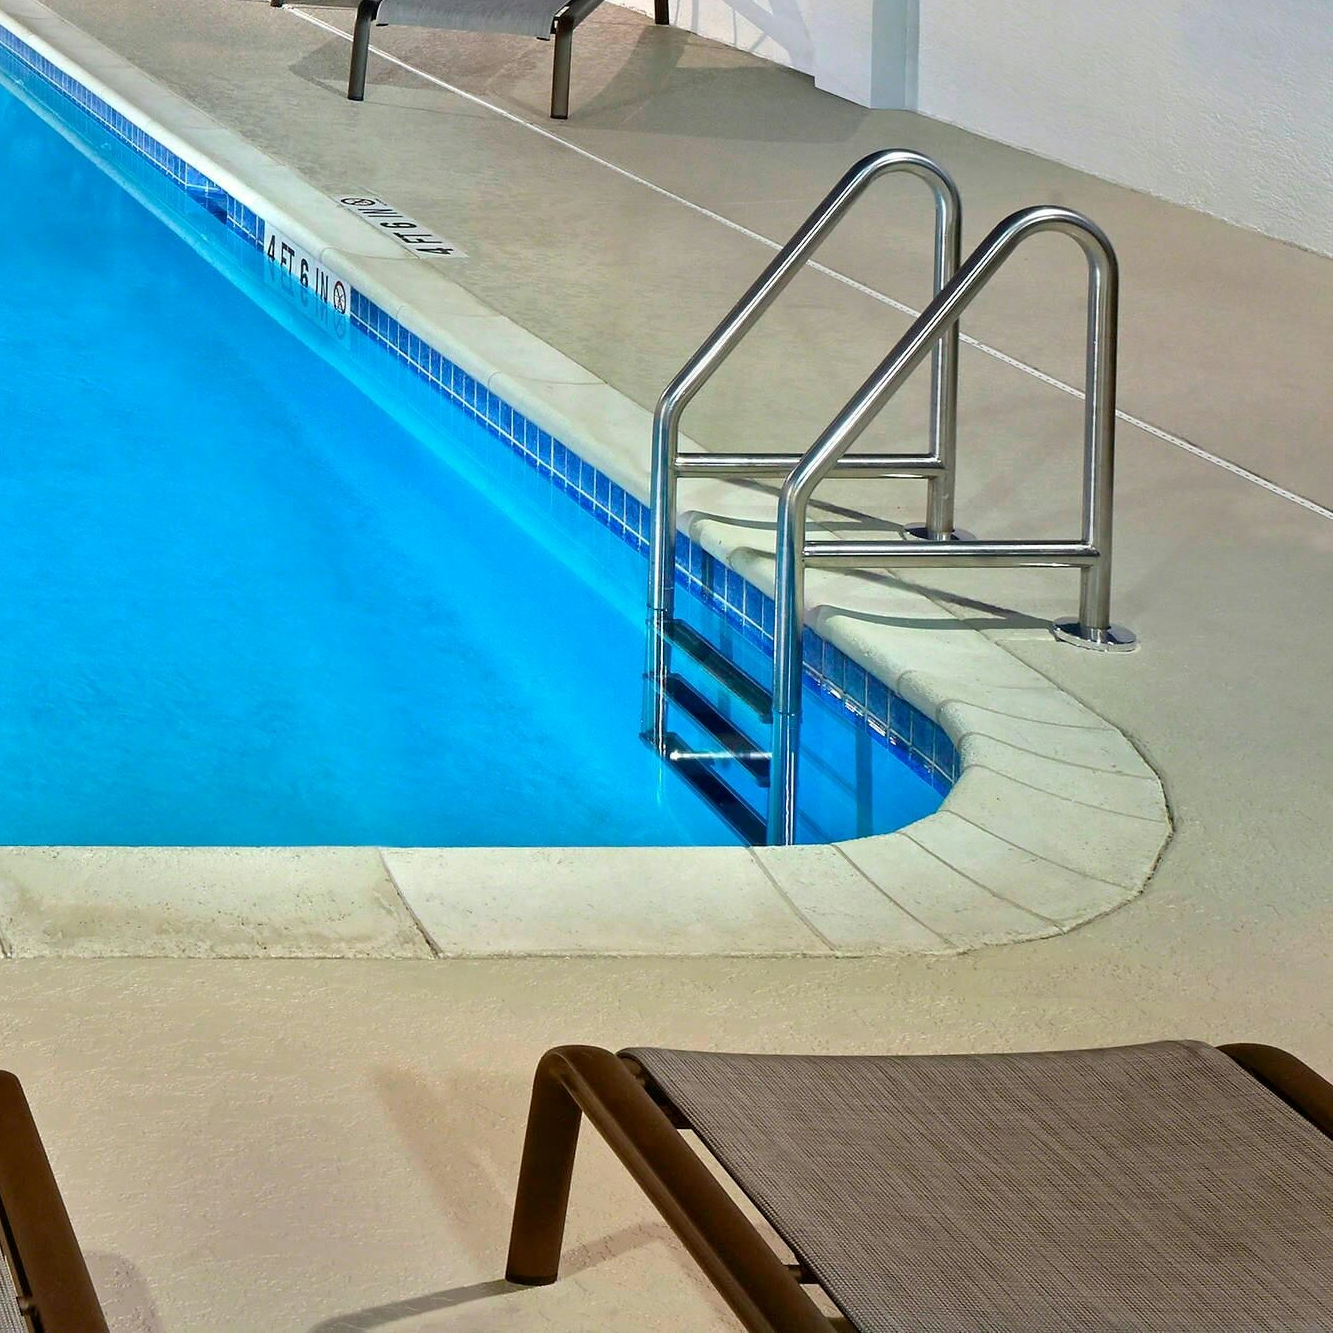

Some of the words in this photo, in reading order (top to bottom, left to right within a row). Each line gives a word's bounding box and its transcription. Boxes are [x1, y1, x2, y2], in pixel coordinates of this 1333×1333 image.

[393, 232, 443, 243] FT
[267, 235, 275, 262] 4
[281, 241, 295, 275] FT
[300, 258, 309, 288] 6
[316, 267, 328, 304] IN
